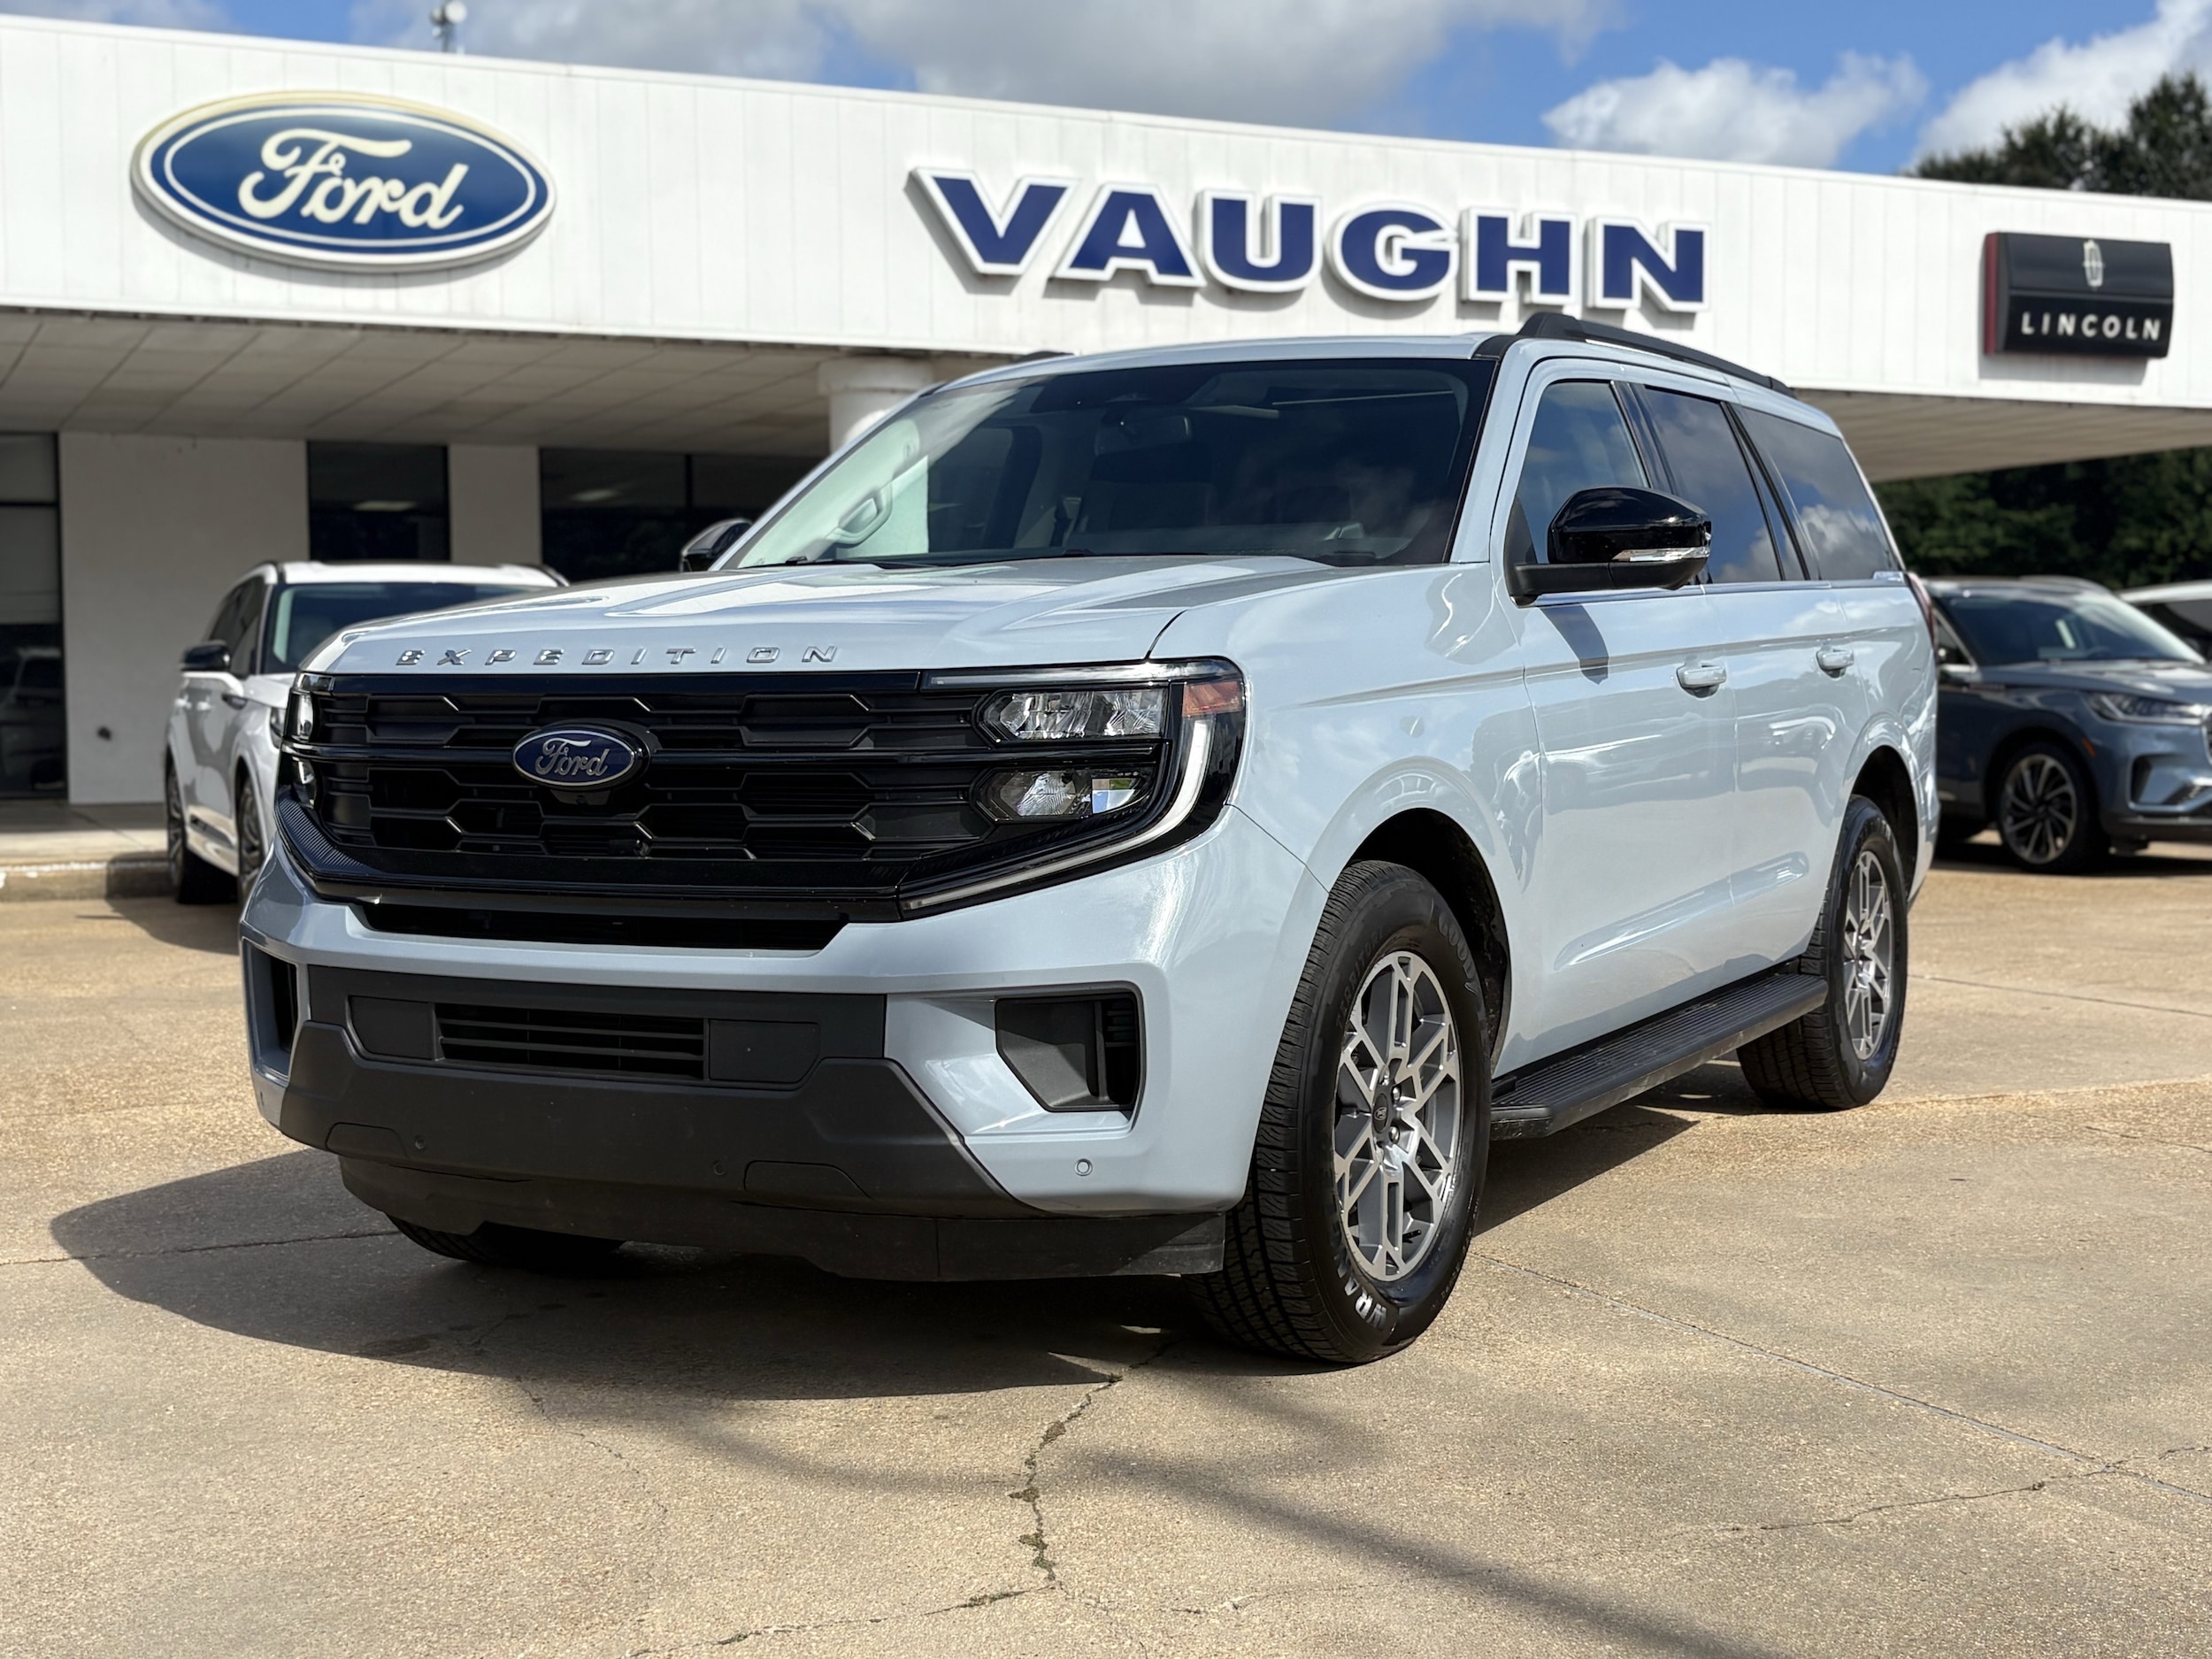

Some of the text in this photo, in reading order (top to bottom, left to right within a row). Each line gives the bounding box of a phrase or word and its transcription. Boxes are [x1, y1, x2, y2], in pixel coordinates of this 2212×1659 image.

[238, 128, 469, 229] Ford
[924, 173, 1708, 309] VAUGHN
[2021, 311, 2161, 341] LINCOLN
[396, 645, 839, 666] EXPEDITION
[534, 737, 611, 777] Ford
[1438, 911, 1479, 996] GOODY
